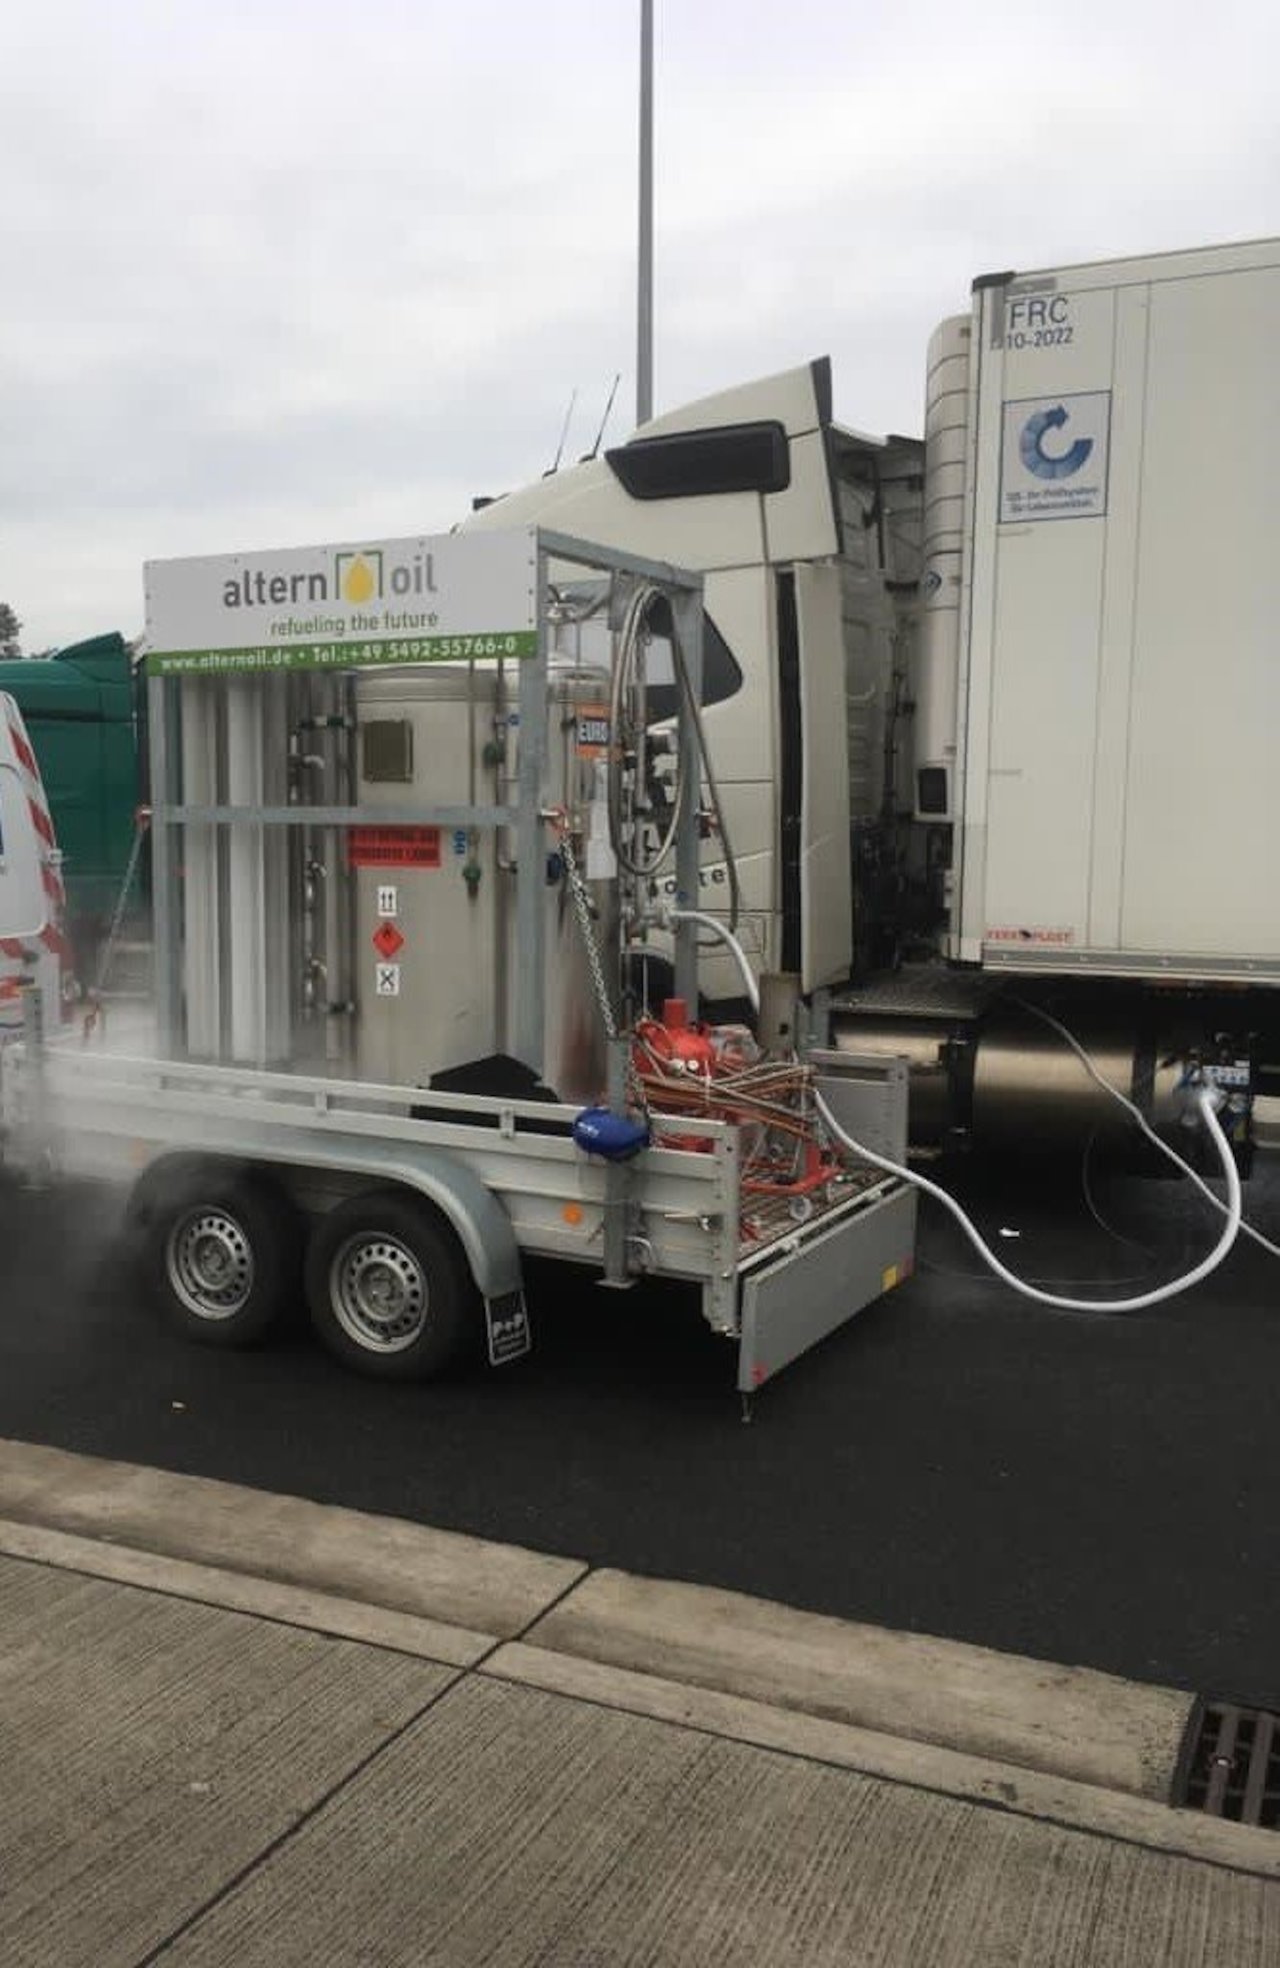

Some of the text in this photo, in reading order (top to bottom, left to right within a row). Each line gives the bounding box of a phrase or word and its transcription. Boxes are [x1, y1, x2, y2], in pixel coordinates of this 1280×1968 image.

[1010, 297, 1069, 329] FRC
[1007, 327, 1074, 350] 10-2022
[223, 553, 438, 608] altern oil
[270, 609, 439, 637] refueling the future
[161, 648, 293, 671] www.alternoil.de
